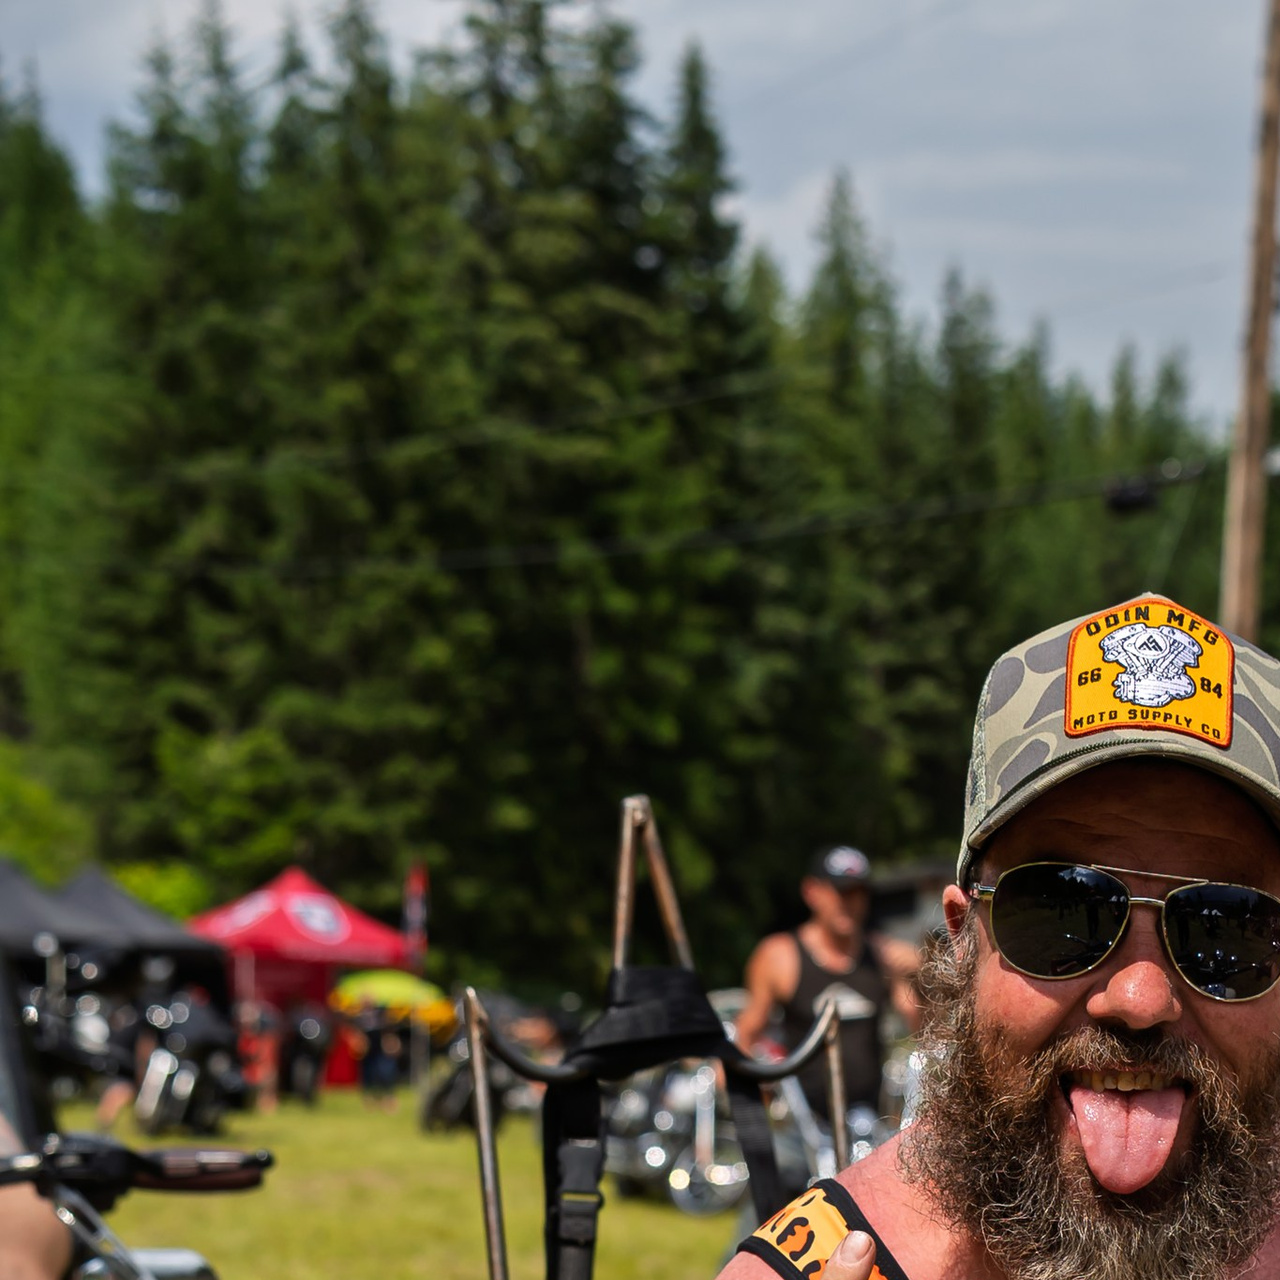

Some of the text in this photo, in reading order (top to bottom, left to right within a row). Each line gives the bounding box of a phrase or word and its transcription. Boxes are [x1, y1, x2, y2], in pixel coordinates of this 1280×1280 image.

[1086, 606, 1219, 645] ODIN MFG
[1078, 668, 1222, 699] 66 84
[1073, 709, 1221, 739] MOTO SUPPLY CO
